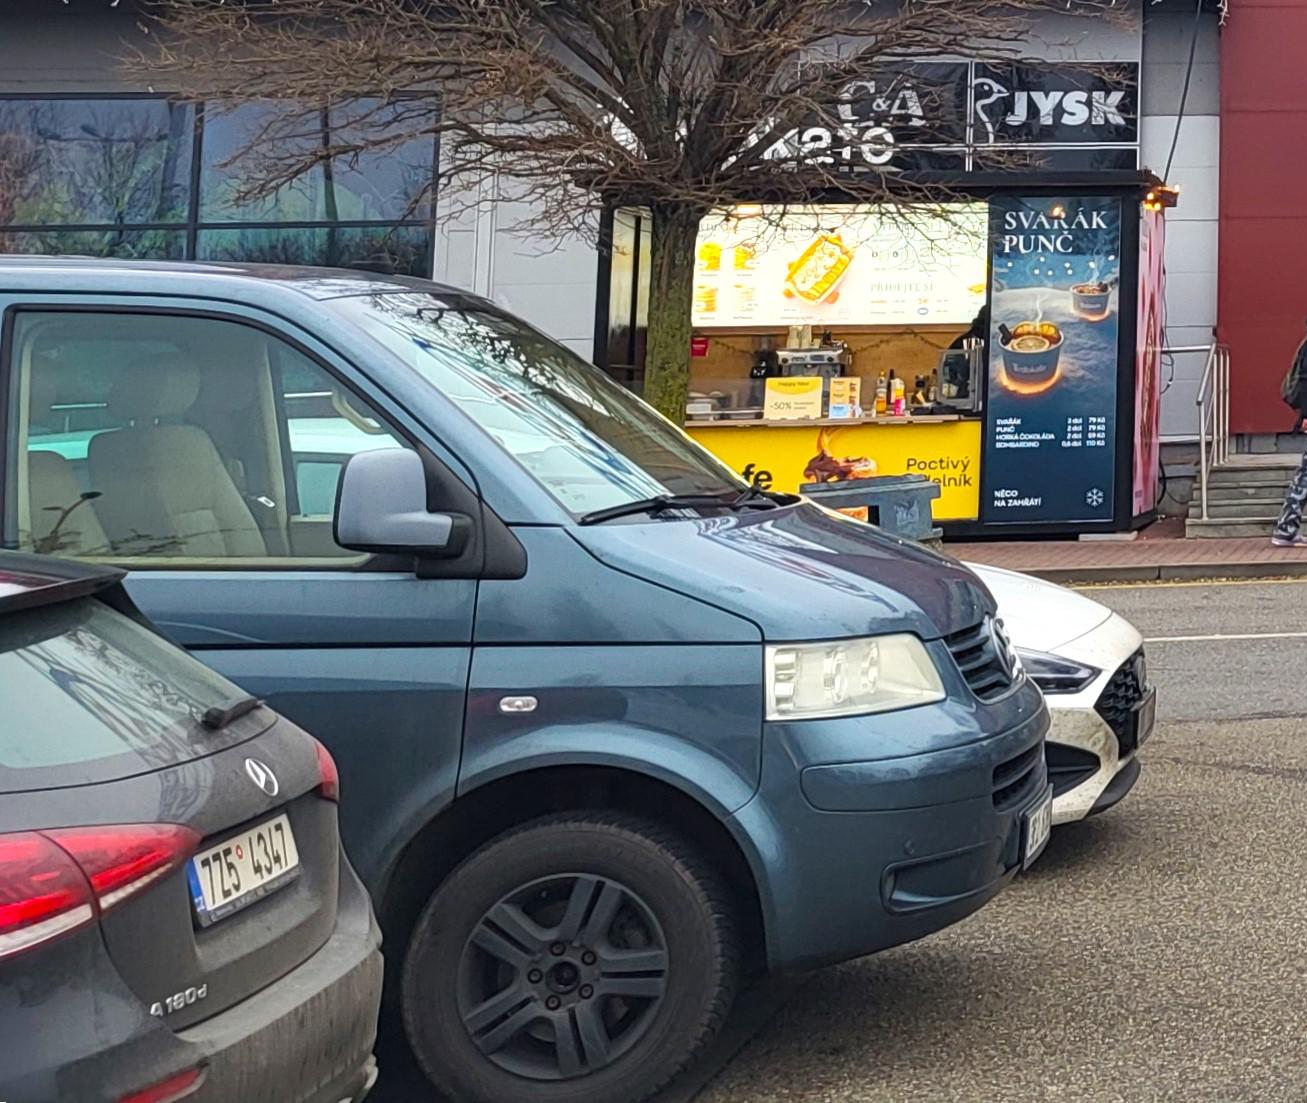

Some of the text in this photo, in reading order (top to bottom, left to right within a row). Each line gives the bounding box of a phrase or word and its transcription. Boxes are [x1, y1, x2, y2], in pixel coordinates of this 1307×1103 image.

[1004, 89, 1127, 127] JYSK
[1003, 230, 1074, 254] PUNČ
[906, 456, 971, 473] Poctivý
[994, 489, 1018, 498] NĚCO
[1007, 497, 1042, 507] ZAHŘÁTÍ
[248, 821, 289, 881] 4347
